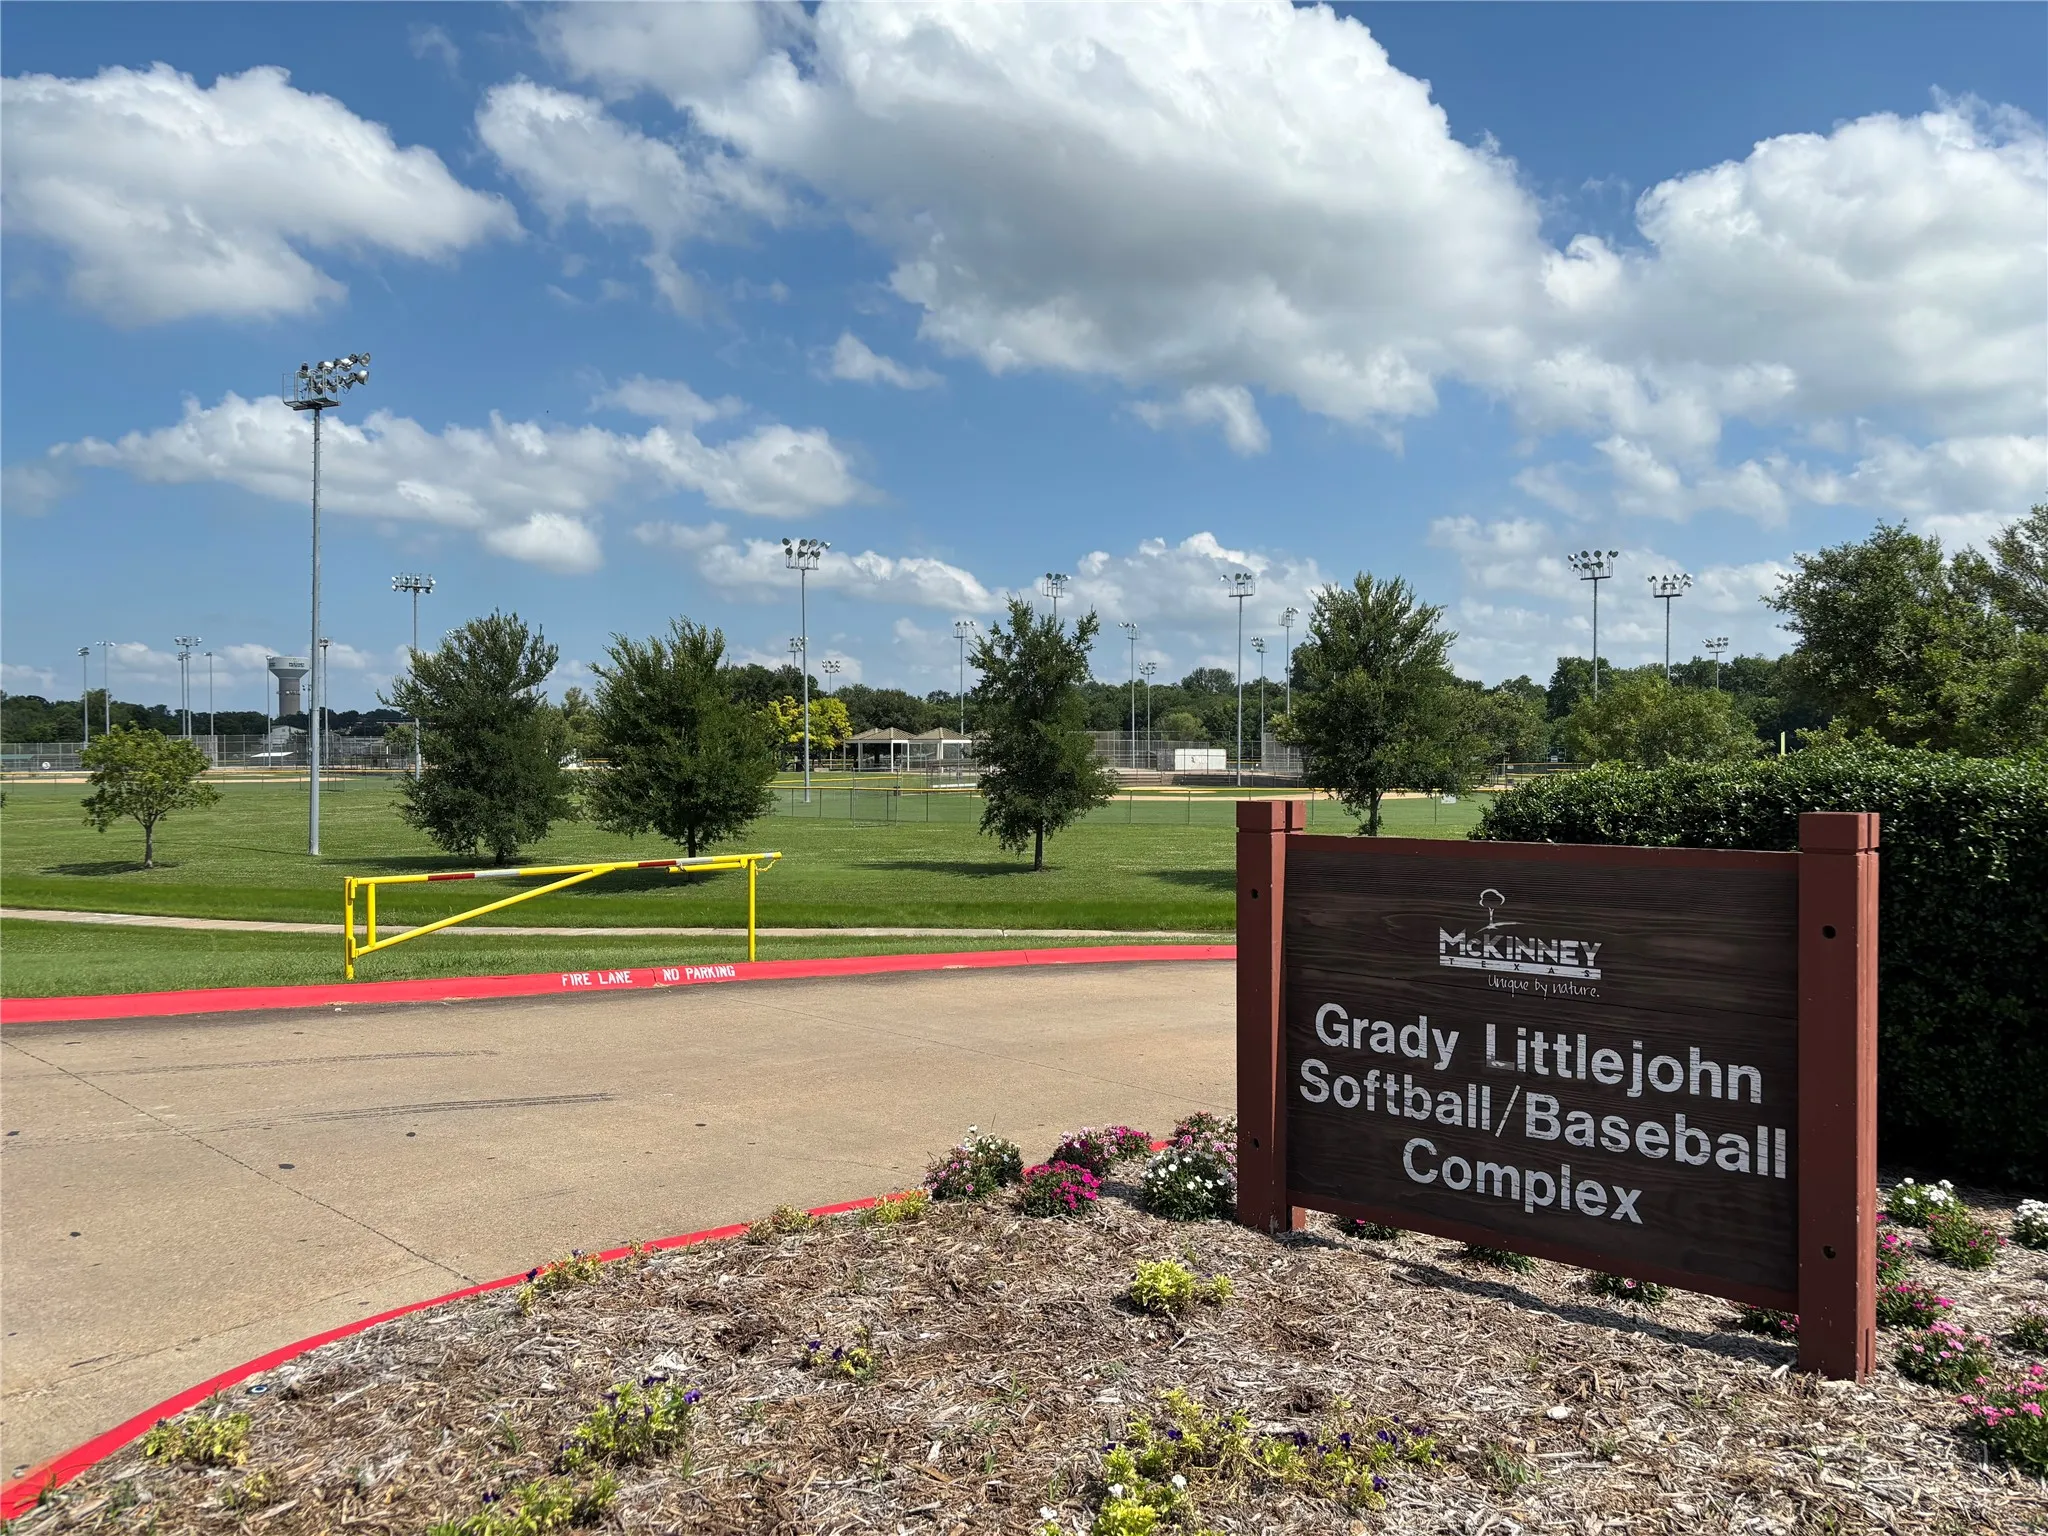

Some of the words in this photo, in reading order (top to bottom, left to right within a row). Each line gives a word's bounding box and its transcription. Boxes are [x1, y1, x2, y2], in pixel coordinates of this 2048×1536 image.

[561, 973, 592, 987] FIRE
[599, 971, 633, 985] LANE
[662, 968, 680, 981] NO
[686, 966, 736, 980] PARKING
[1449, 957, 1590, 977] TEXAS
[1488, 974, 1529, 997] Unique
[1534, 978, 1548, 1000] by
[1552, 981, 1600, 998] nature.
[1315, 1003, 1459, 1071] Grady
[1485, 1023, 1762, 1104] Littlejohn
[1299, 1059, 1787, 1179] Softball/Baseball
[1403, 1137, 1644, 1225] Complex
